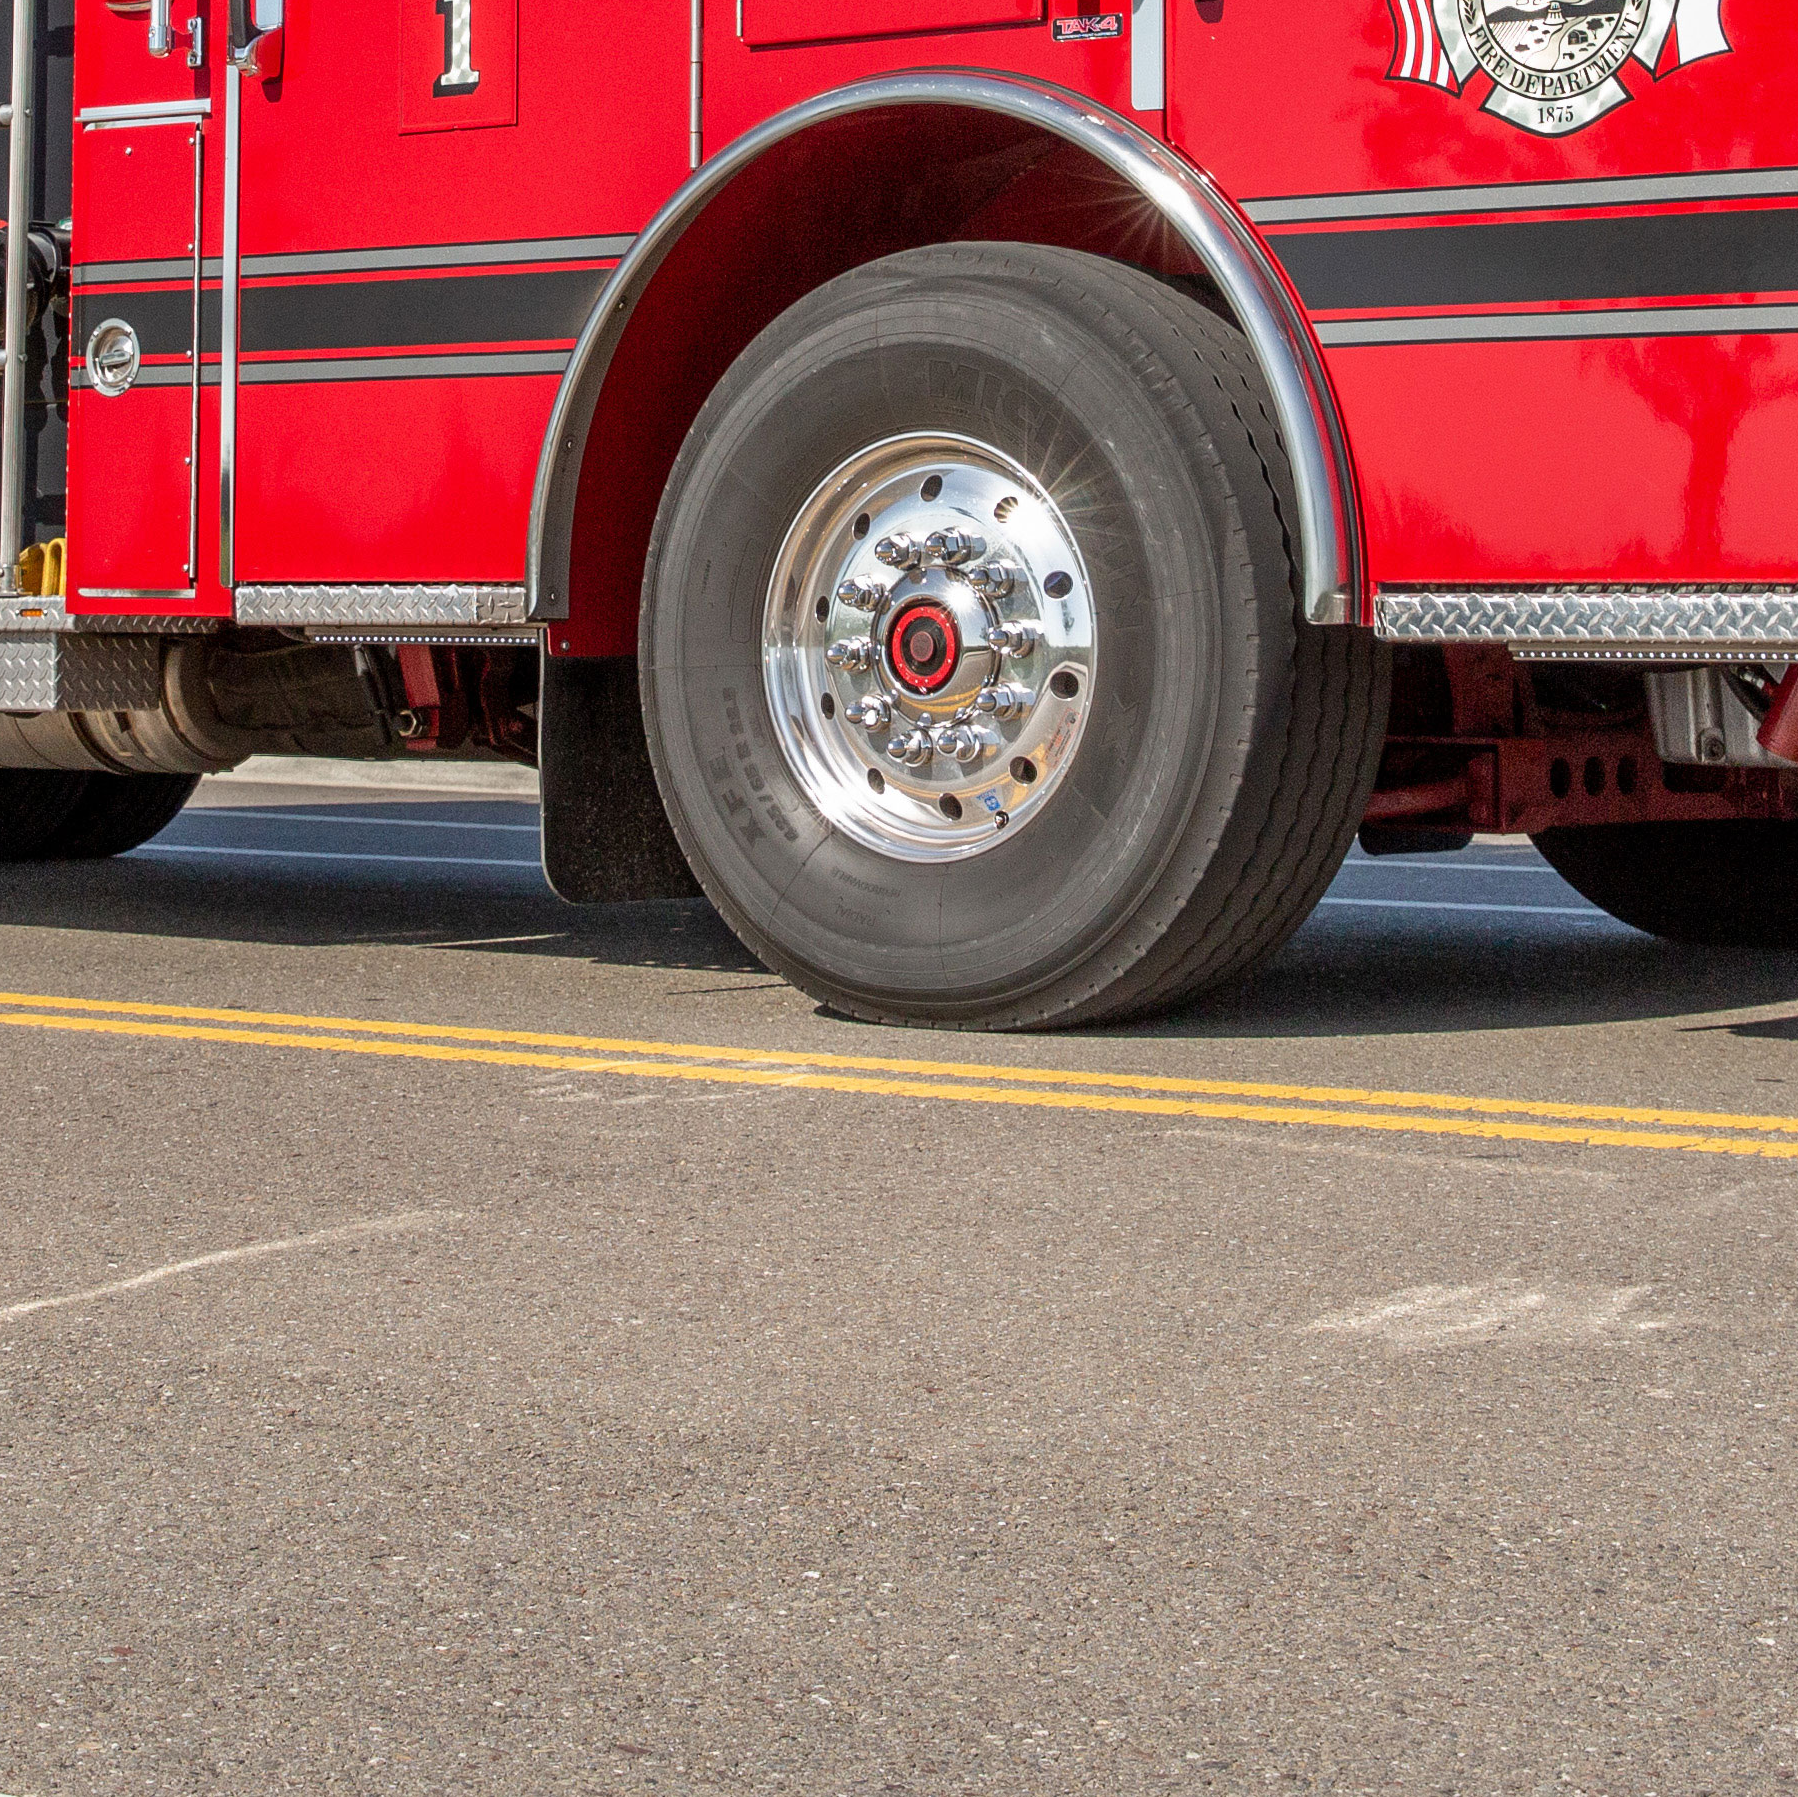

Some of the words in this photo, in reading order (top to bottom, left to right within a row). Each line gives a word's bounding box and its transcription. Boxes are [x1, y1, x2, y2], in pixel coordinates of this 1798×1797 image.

[1056, 15, 1118, 35] TAK-4
[1468, 27, 1507, 77] FIRE
[1510, 16, 1642, 96] DEPARTMENT
[1536, 105, 1574, 124] 1875
[928, 358, 1143, 630] MICHIN
